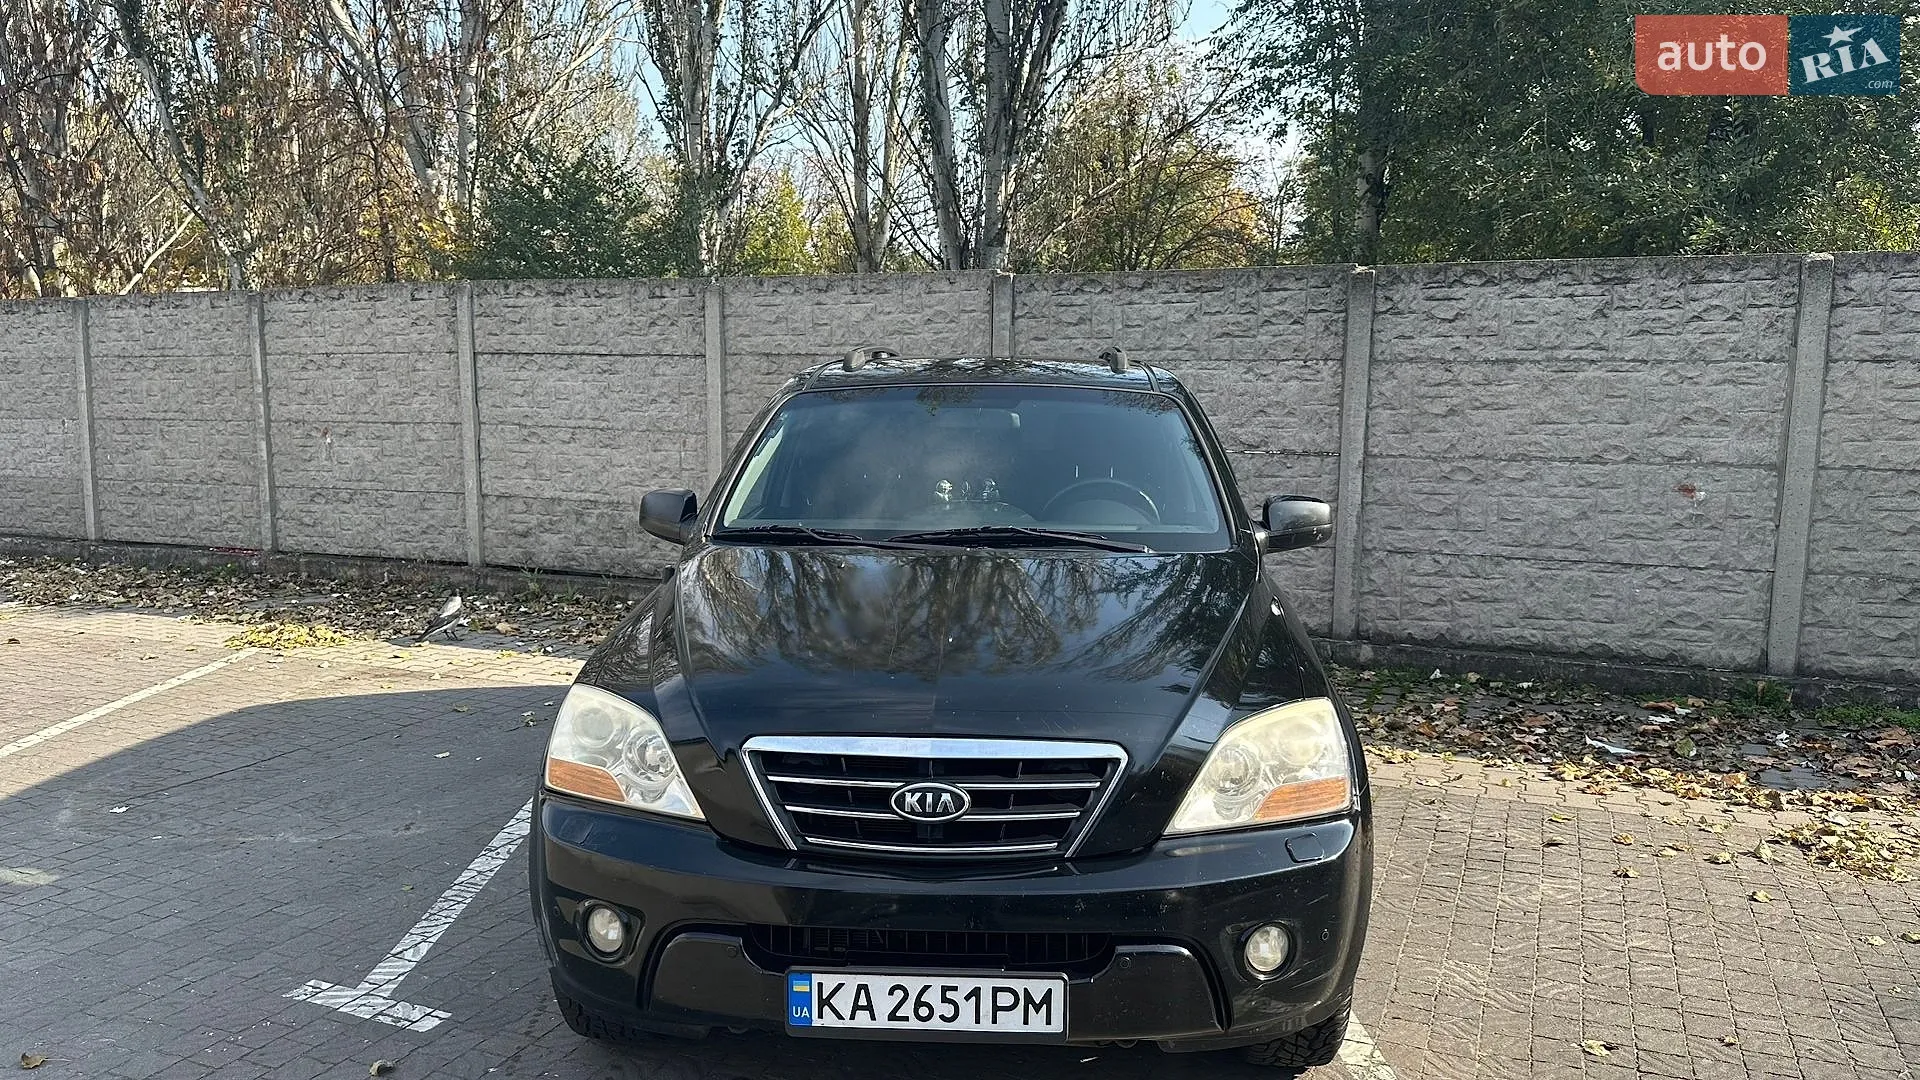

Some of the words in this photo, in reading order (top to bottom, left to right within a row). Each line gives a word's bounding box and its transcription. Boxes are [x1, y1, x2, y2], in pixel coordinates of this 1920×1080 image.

[904, 792, 956, 813] KIA
[792, 1006, 810, 1018] UA
[816, 981, 877, 1022] KA
[887, 984, 981, 1025] 2651
[991, 986, 1053, 1026] PM
